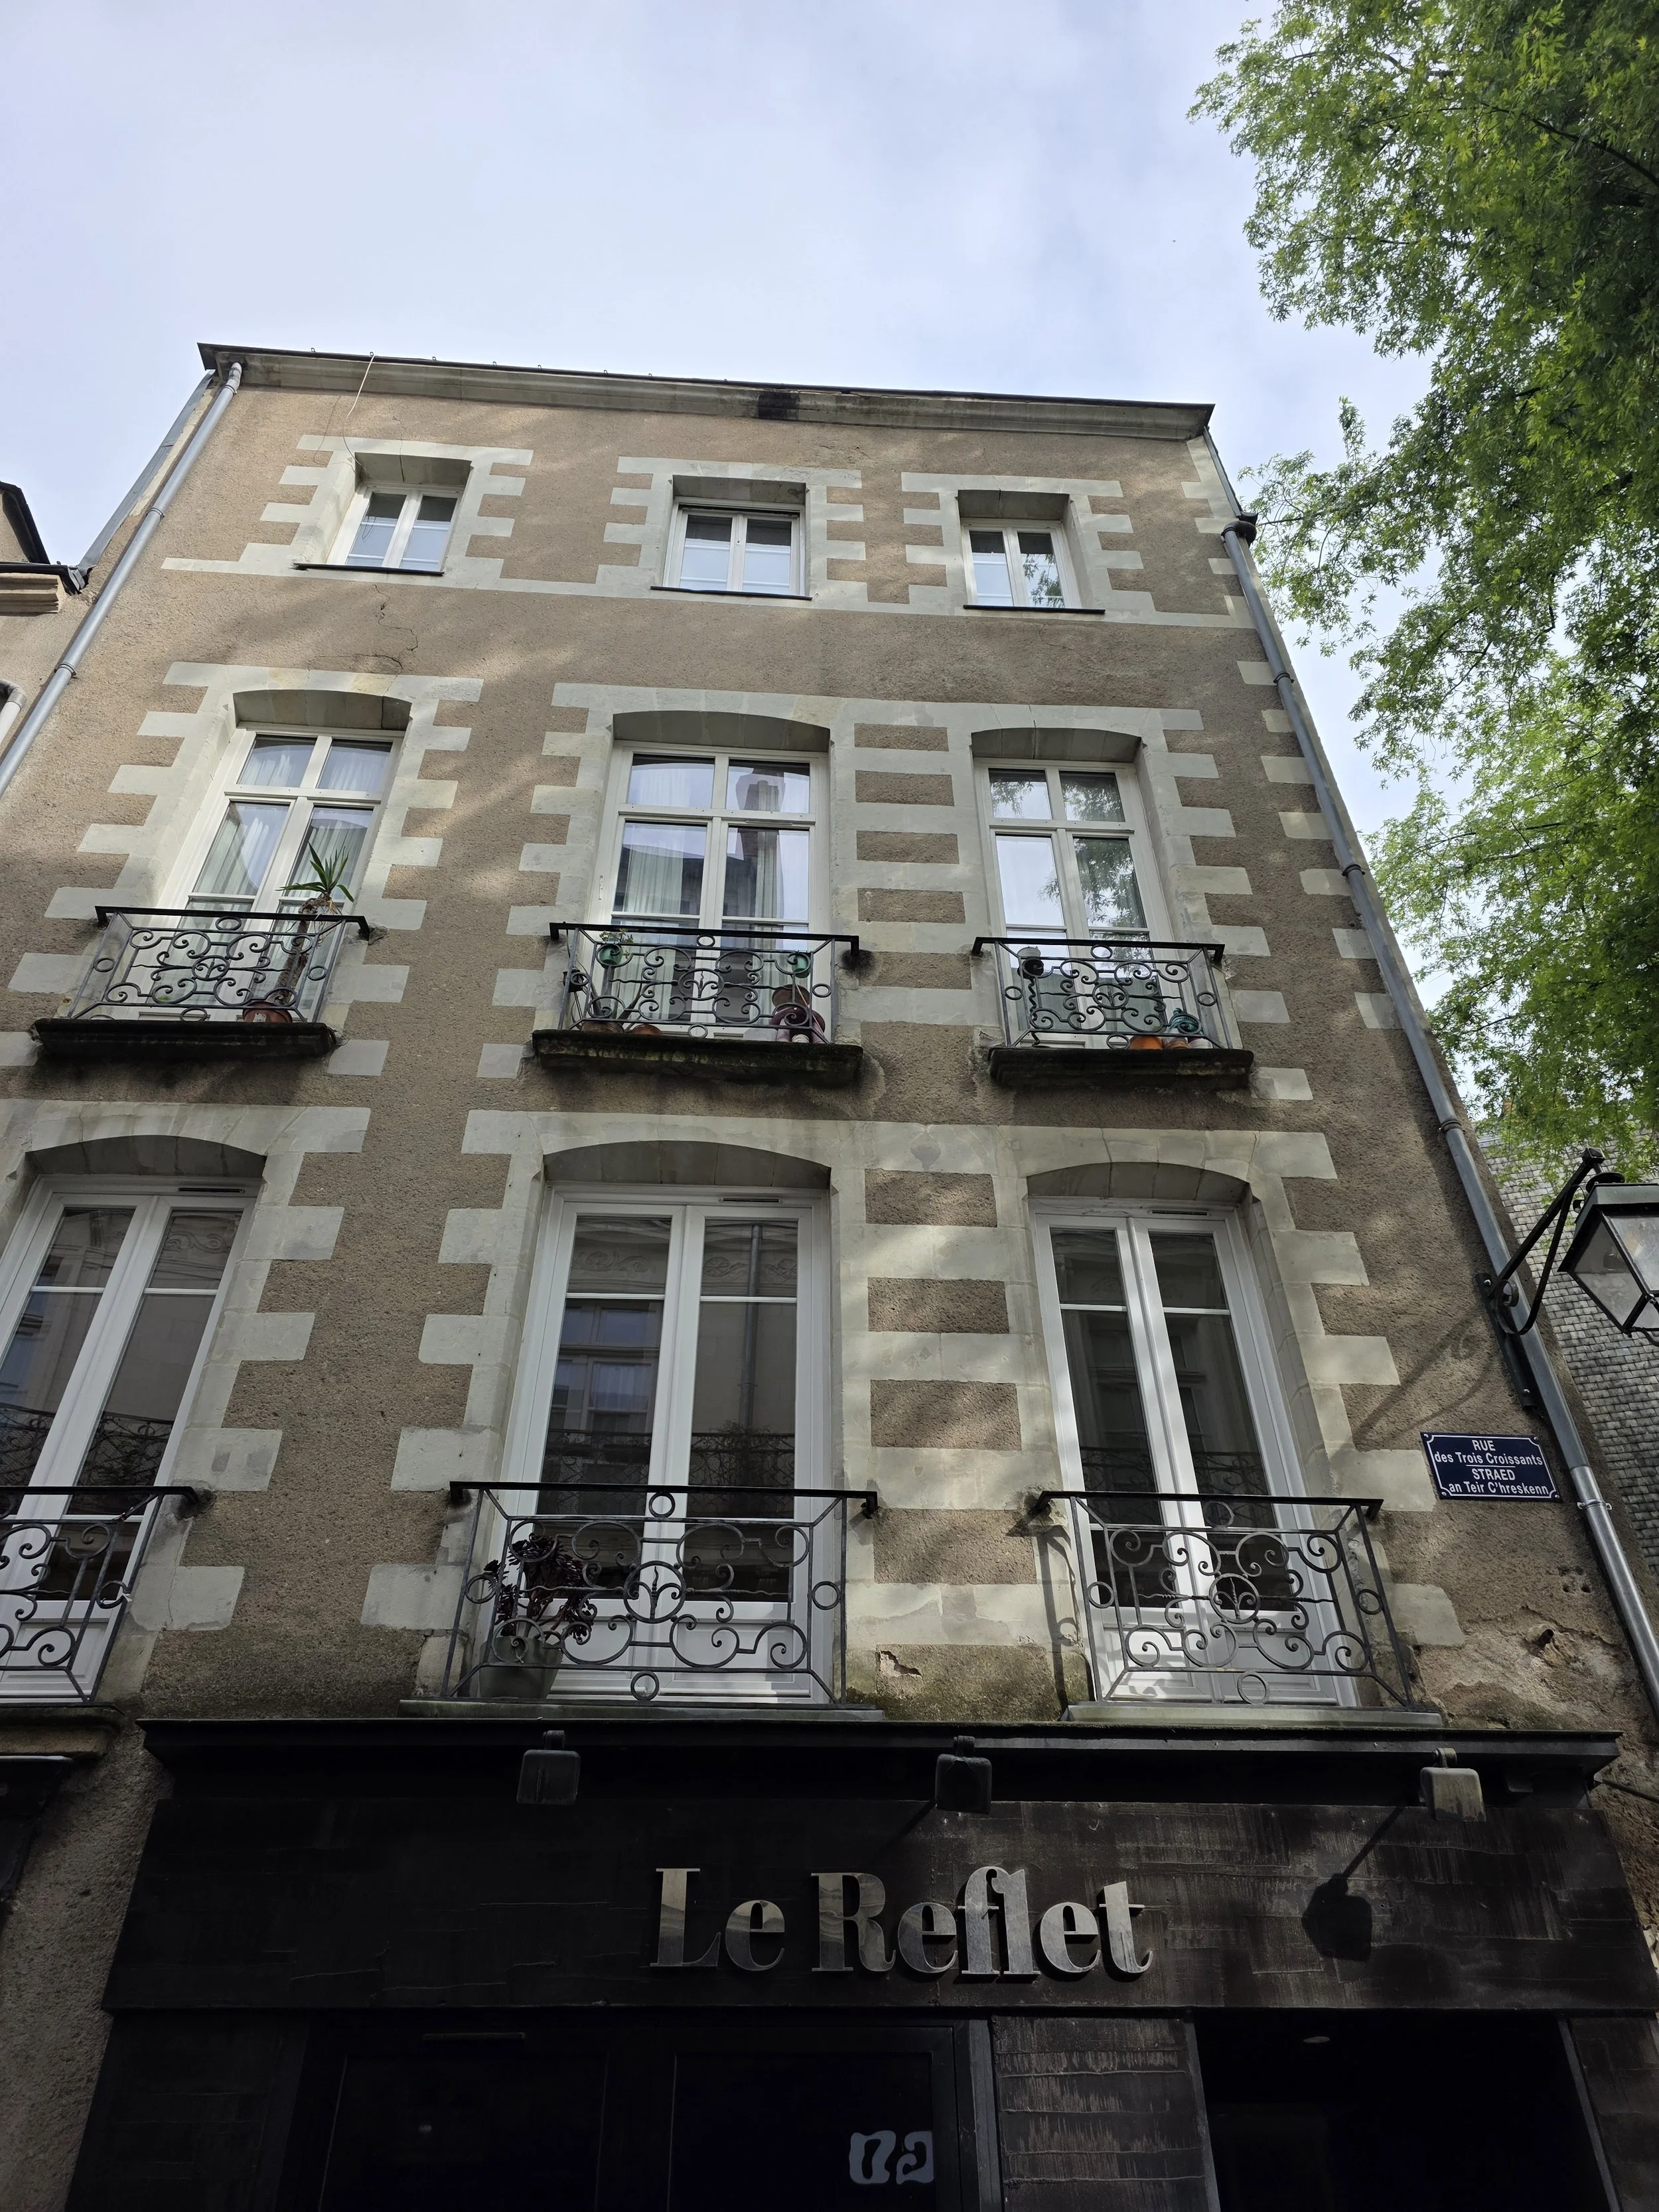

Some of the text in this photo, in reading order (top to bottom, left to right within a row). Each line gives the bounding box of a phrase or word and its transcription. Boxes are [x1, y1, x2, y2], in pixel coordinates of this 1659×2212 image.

[1472, 1440, 1496, 1451] RUE
[1435, 1451, 1543, 1465] des Trois Croissants
[1472, 1469, 1515, 1481] STRAED
[1449, 1481, 1549, 1495] an Teir C'hreskenn
[650, 1866, 1153, 1976] Le Reflet
